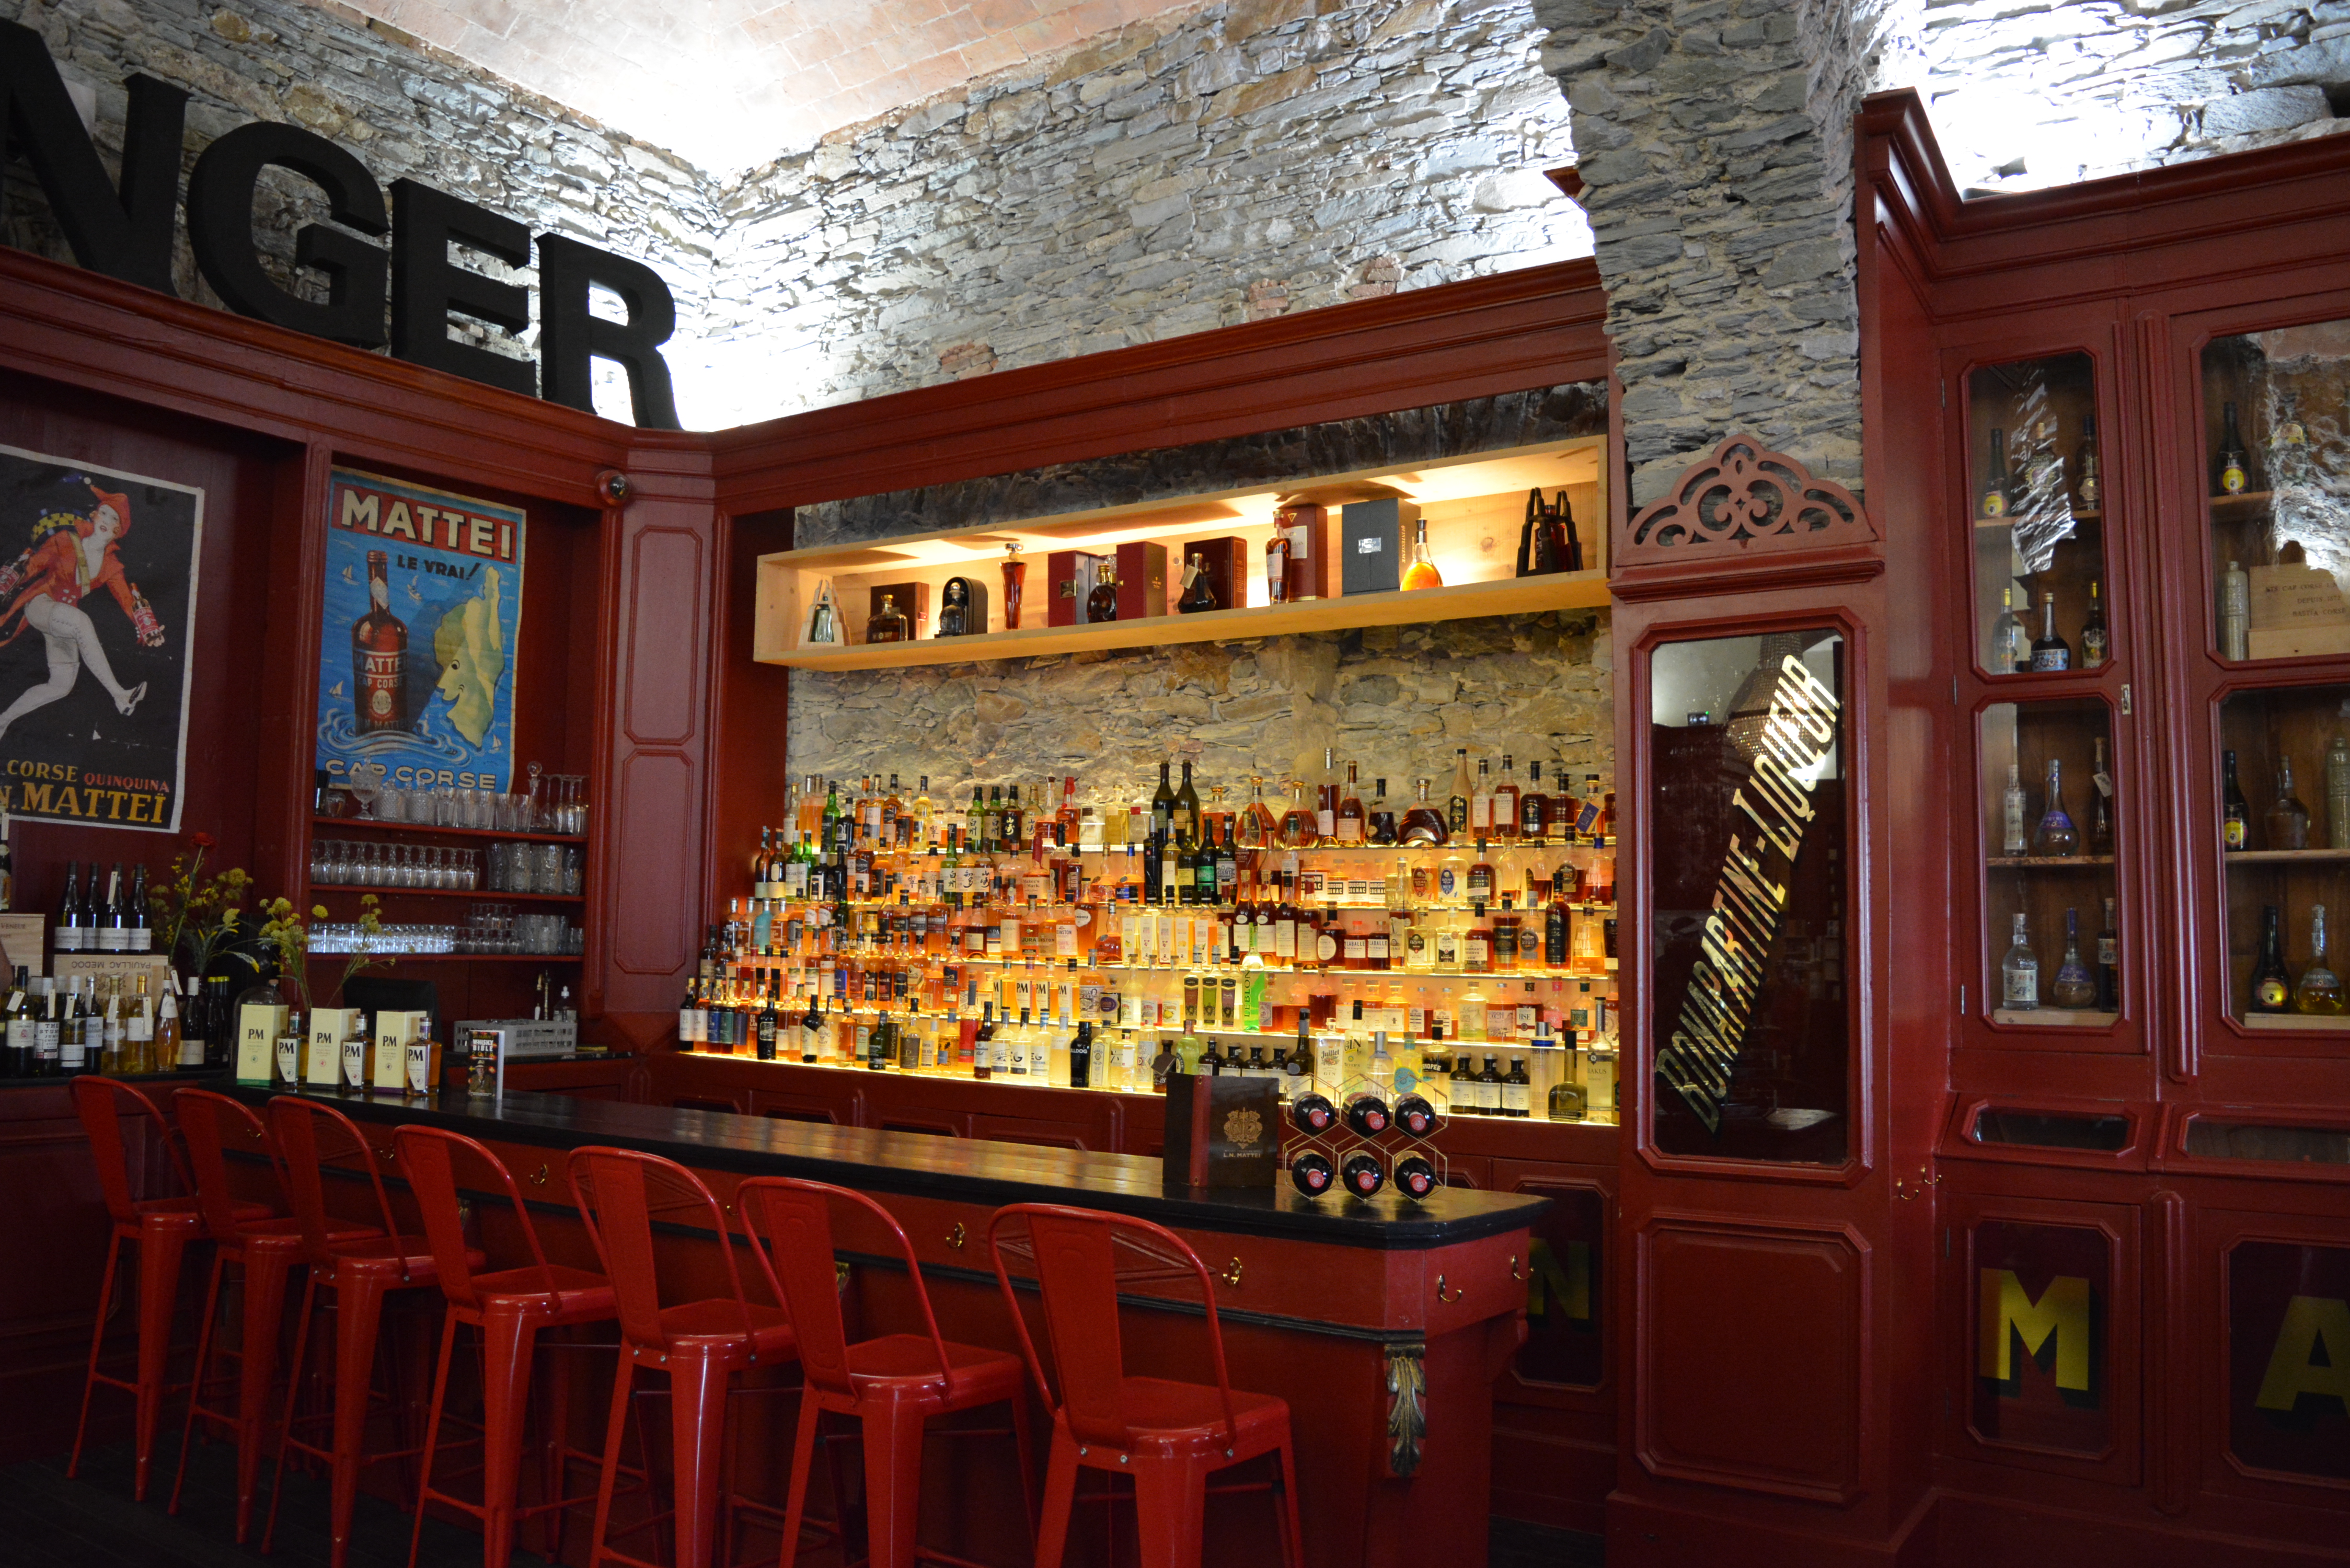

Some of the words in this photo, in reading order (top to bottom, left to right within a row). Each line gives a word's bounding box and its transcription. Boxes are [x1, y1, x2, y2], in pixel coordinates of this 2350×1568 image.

[341, 489, 512, 559] MATTEI
[397, 555, 417, 570] LE
[7, 760, 78, 782] CORSE
[84, 773, 169, 793] QUINQUINA
[395, 766, 496, 789] CORSE
[21, 782, 166, 824] MATTEÏ
[1321, 1050, 1340, 1059] Juillet
[1344, 1037, 1362, 1052] GIN
[1978, 1267, 2090, 1392] M
